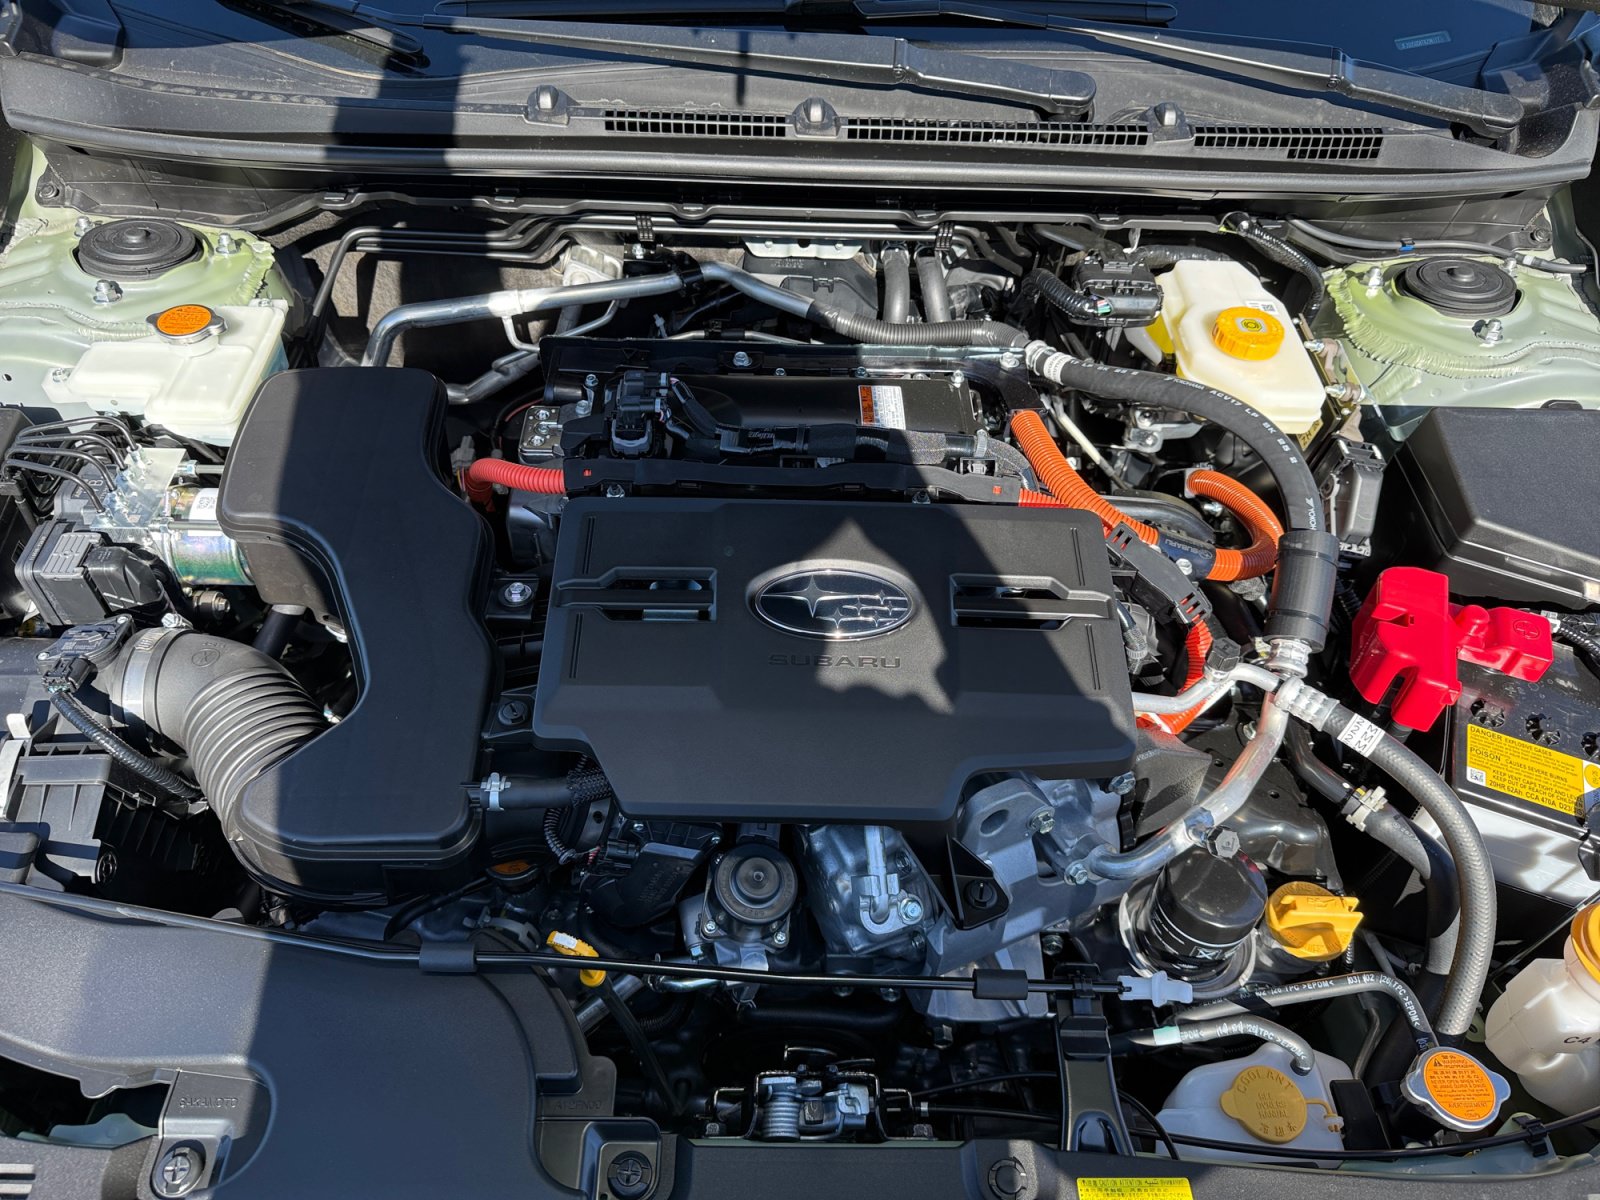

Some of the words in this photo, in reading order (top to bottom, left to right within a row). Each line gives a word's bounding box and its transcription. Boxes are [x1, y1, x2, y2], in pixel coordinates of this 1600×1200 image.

[1210, 390, 1243, 406] ACV17
[1244, 408, 1260, 418] LP
[1164, 538, 1200, 554] SUBARU
[768, 654, 901, 669] SUBARU
[1470, 726, 1502, 740] DANGER
[1505, 738, 1532, 751] EXPLOSIVE
[1470, 747, 1501, 762] POISON
[1506, 759, 1527, 770] CAUSES
[1492, 769, 1507, 777] KEEP
[1522, 779, 1536, 788] CAPS
[1538, 784, 1554, 793] TIGHT
[1492, 775, 1507, 783] KEEP
[1528, 786, 1546, 796] REACH
[1525, 791, 1540, 801] CCA
[1392, 980, 1406, 995] TPC
[1259, 1027, 1274, 1040] TPC
[1236, 1069, 1294, 1094] COOLANT
